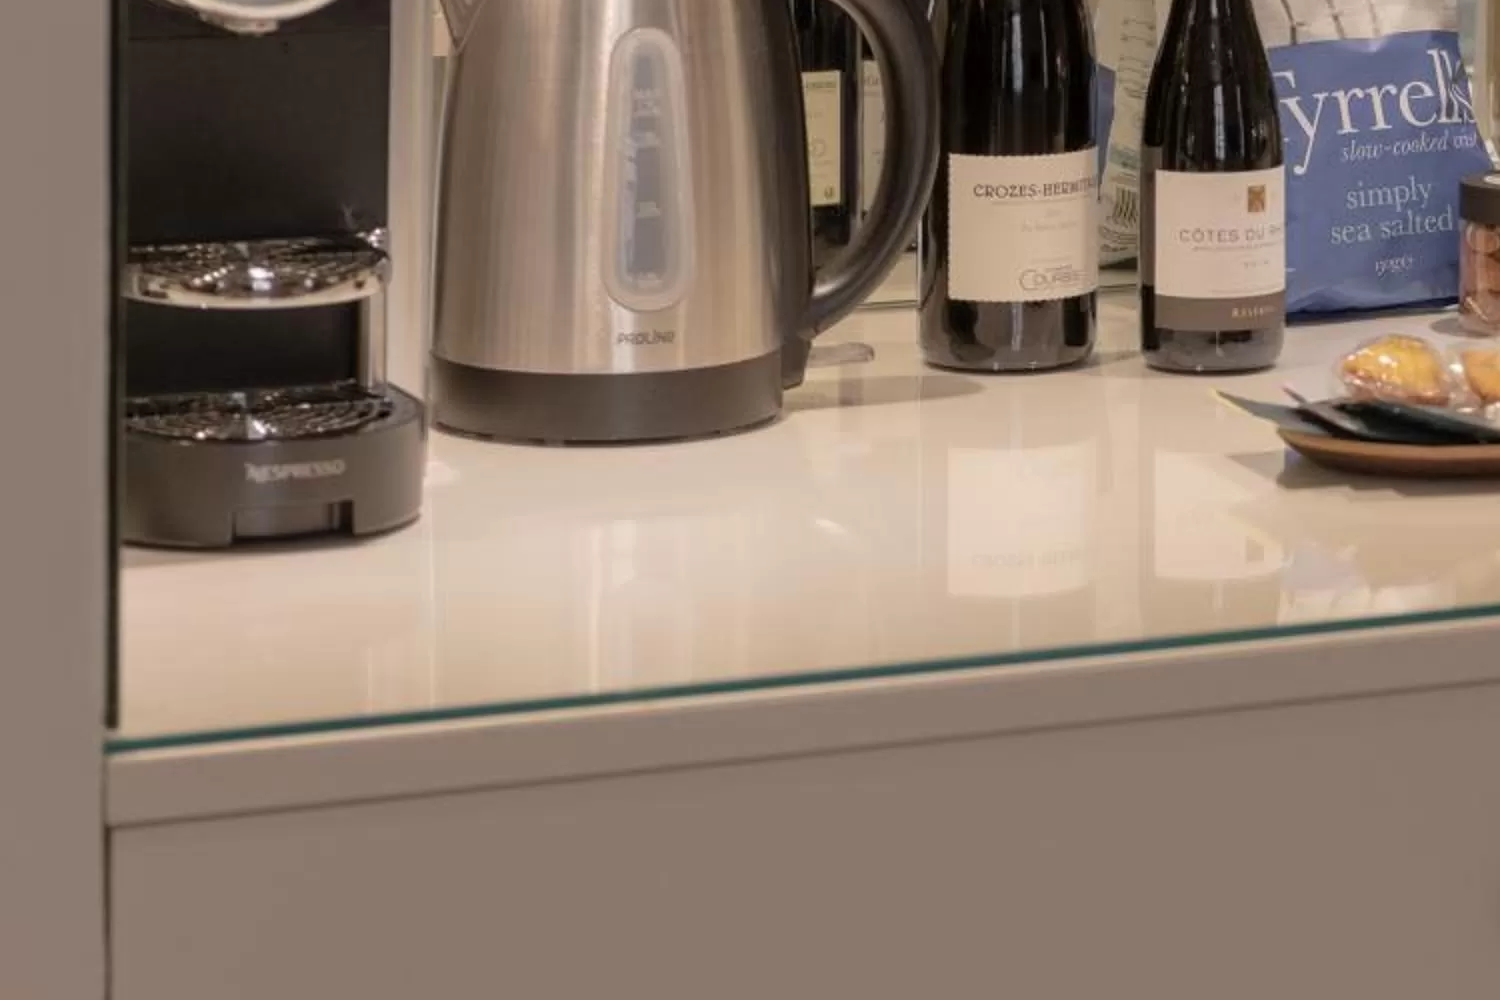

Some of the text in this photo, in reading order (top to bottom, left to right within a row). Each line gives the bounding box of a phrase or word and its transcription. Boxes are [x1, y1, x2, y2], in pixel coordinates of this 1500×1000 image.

[1273, 48, 1476, 176] yrrell
[1341, 128, 1449, 161] slow-cooked
[1346, 174, 1432, 213] simply
[1330, 203, 1453, 245] sea salted
[244, 459, 347, 484] NESPRESSO
